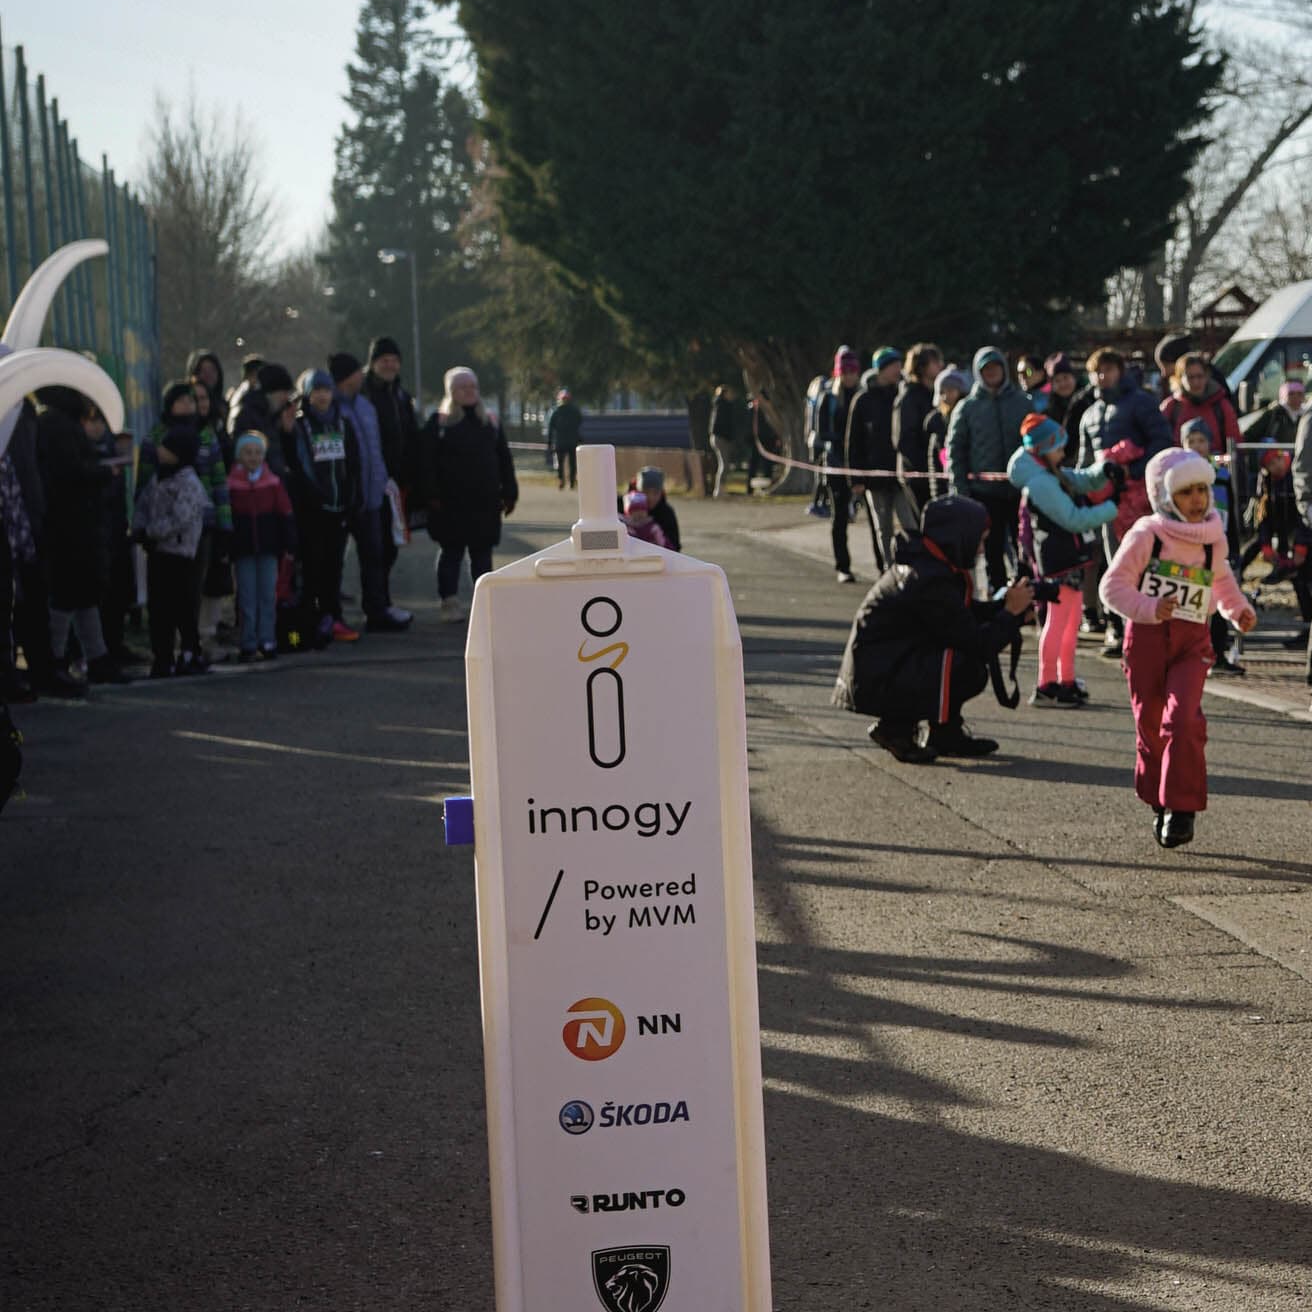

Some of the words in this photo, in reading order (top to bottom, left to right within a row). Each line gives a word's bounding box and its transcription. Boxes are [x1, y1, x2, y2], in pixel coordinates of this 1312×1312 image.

[1147, 576, 1204, 610] 3214
[527, 798, 692, 838] innogy
[584, 873, 697, 901] Powered
[584, 910, 617, 936] by
[628, 904, 697, 929] MVM
[637, 1013, 682, 1037] NN
[598, 1100, 691, 1129] ŠKODA
[592, 1187, 686, 1214] RUNTO
[598, 1251, 664, 1265] PEUGEOT
